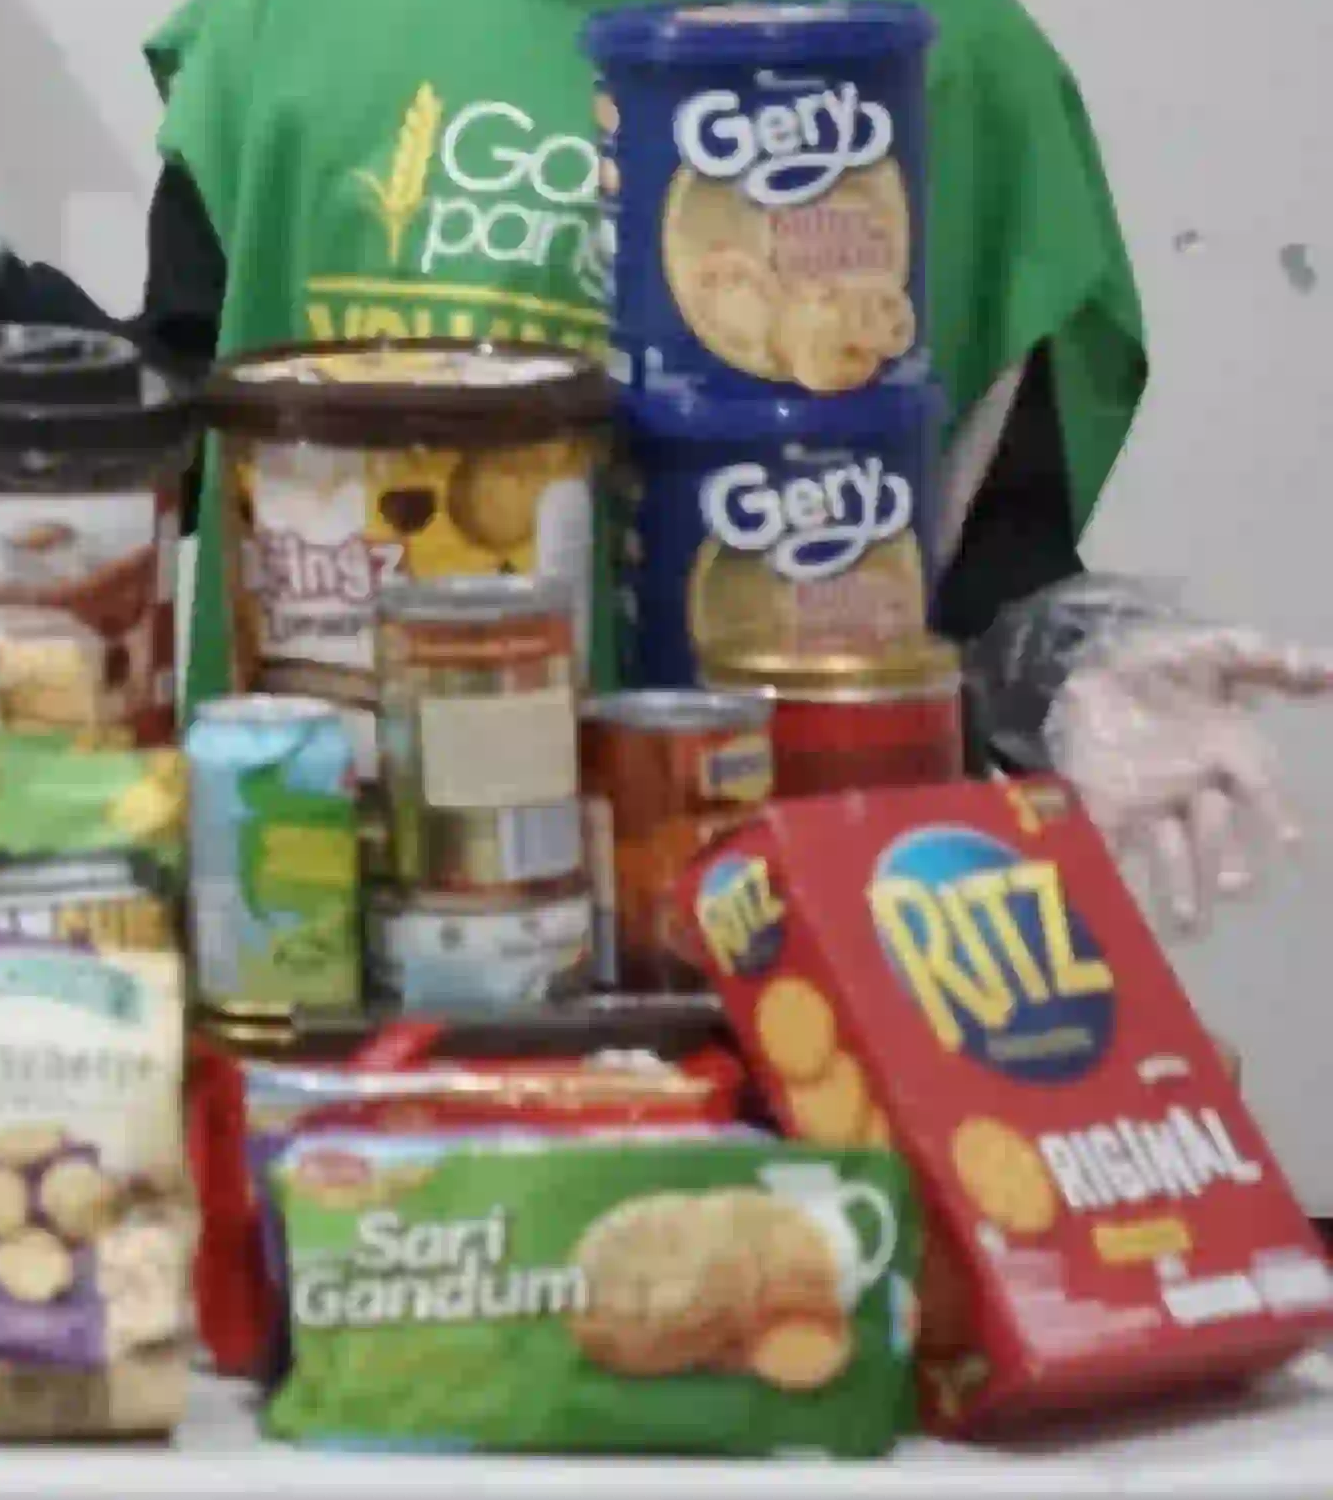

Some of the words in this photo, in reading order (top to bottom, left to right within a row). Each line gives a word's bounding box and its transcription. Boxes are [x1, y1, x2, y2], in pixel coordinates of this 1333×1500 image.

[673, 81, 893, 204] Gery
[700, 457, 911, 579] Gery
[695, 856, 783, 974] RITZ
[867, 861, 1113, 1052] RITZ
[295, 1252, 589, 1326] Gandum
[354, 1203, 505, 1268] Sari
